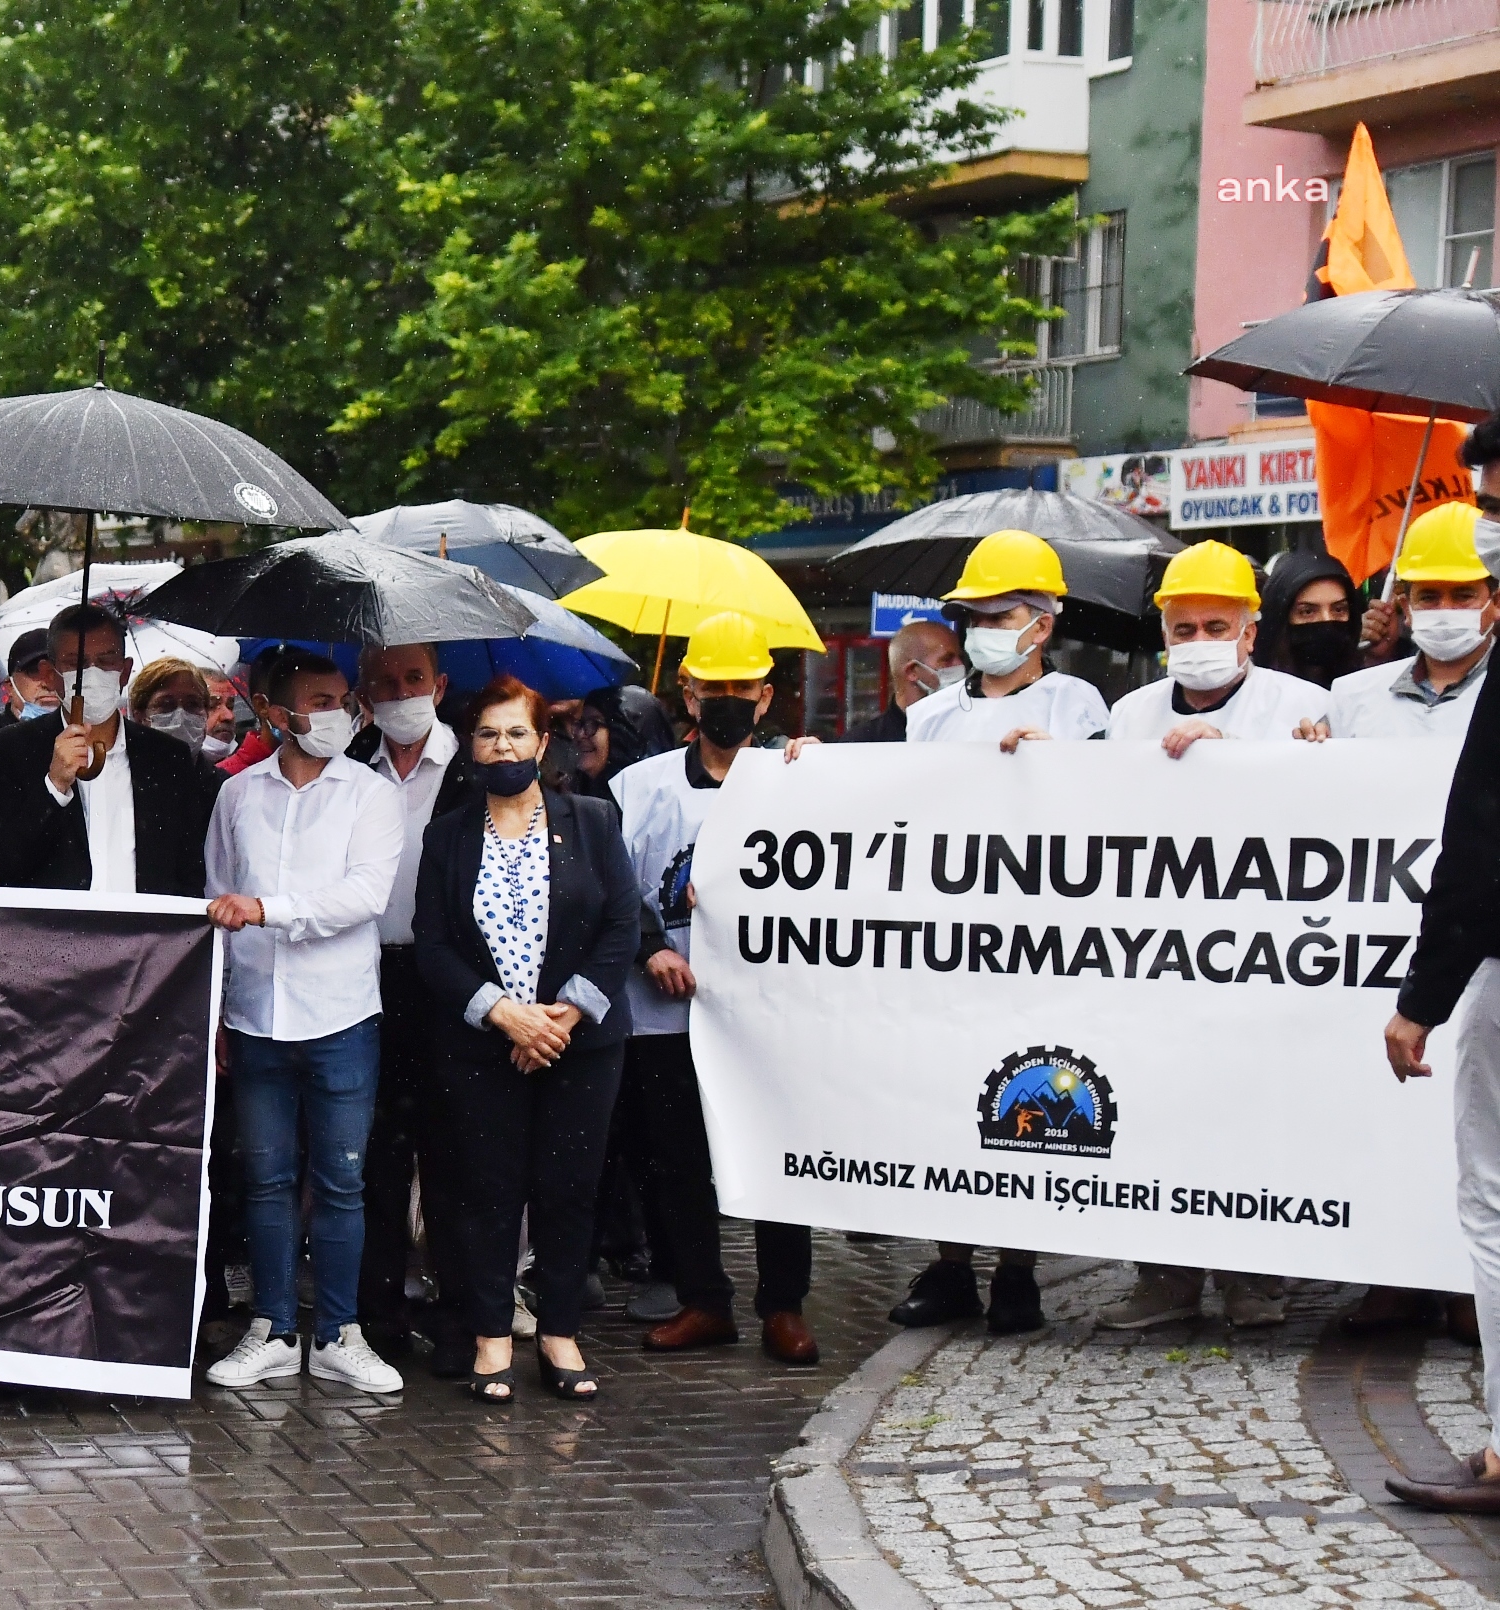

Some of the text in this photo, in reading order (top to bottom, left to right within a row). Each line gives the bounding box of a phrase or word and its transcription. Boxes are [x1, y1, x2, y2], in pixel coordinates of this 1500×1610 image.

[1181, 448, 1317, 491] YANKI KIRT
[1181, 494, 1263, 522] OYUNCAK
[1268, 494, 1281, 517] &
[931, 833, 1437, 904] UNUTMADIK
[738, 915, 1421, 989] UNUTTURMAYACAĞIZ
[1011, 1056, 1045, 1077] MADEN
[1044, 1127, 1069, 1139] 2018
[784, 1150, 1351, 1229] BAĞIMSIZ MADEN İŞÇİLERİ SENDİKASI
